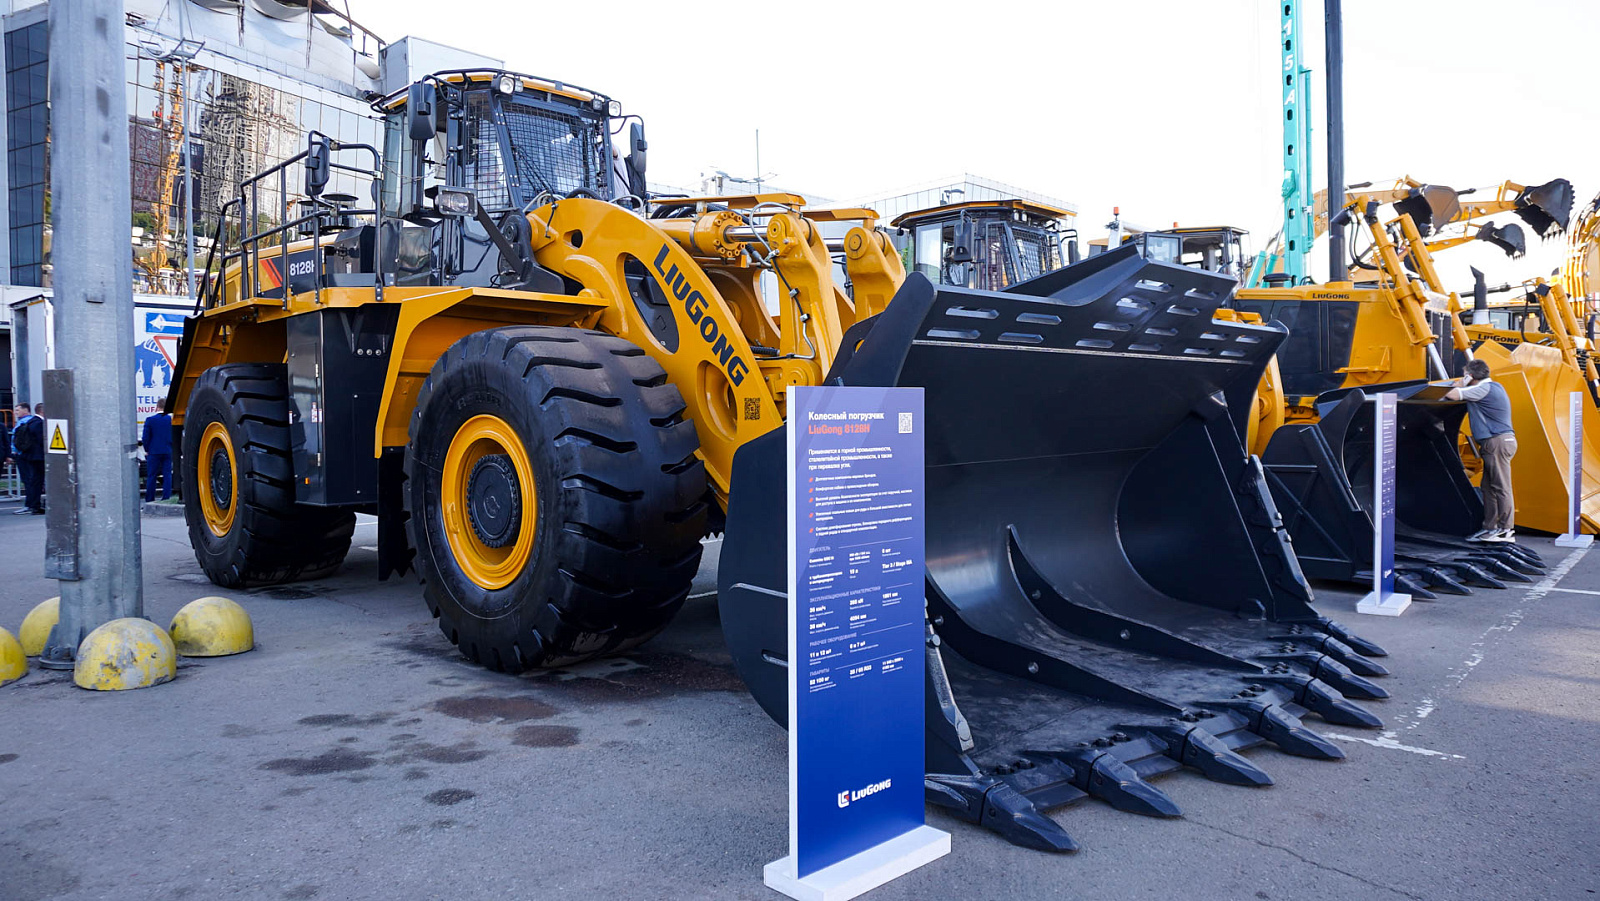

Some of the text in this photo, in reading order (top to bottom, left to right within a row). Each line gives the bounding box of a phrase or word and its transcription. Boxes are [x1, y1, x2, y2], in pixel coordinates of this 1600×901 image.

[653, 243, 750, 387] LIUGONG
[809, 411, 885, 421] Колесный погрузчик
[809, 424, 870, 435] LiuGong 8128H
